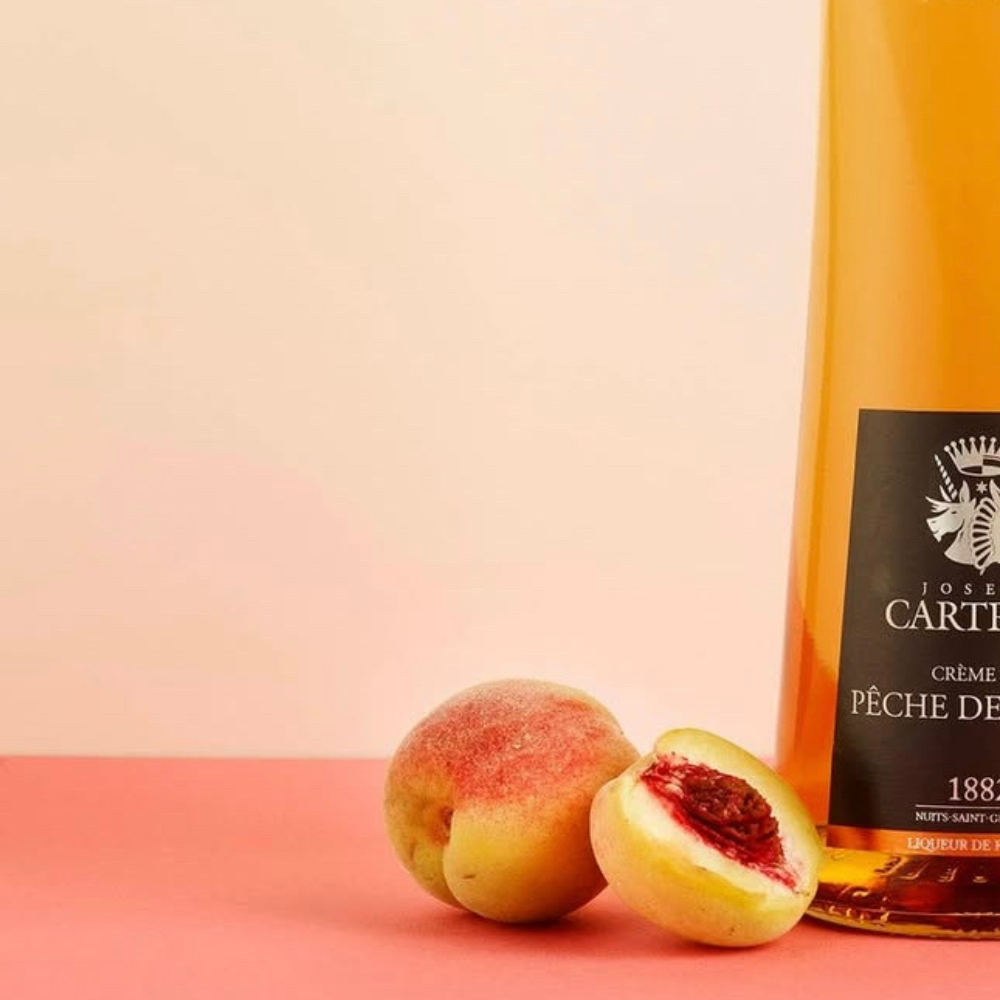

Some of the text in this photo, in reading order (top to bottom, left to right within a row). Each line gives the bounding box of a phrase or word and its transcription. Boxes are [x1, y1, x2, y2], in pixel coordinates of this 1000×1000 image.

[931, 663, 996, 683] CRÈME
[850, 685, 949, 720] PÊCHE
[906, 837, 969, 853] LIQUEUR
[971, 839, 991, 852] DE
